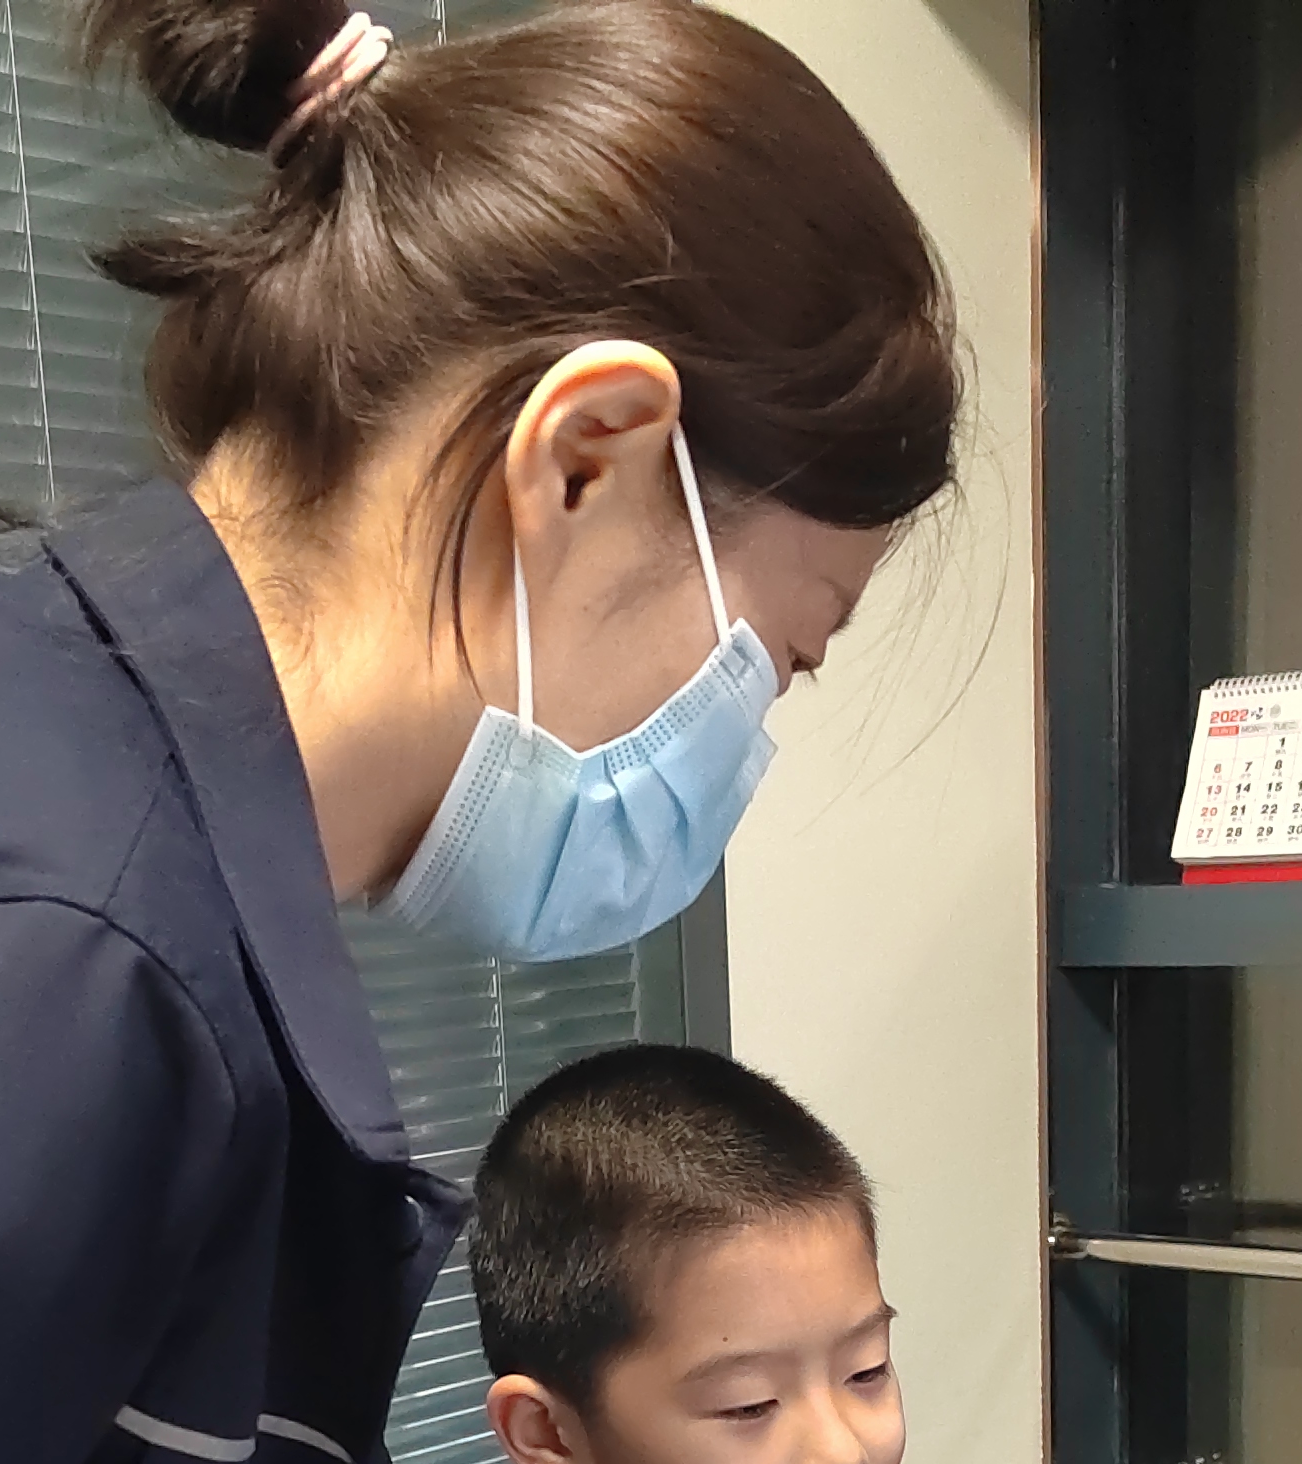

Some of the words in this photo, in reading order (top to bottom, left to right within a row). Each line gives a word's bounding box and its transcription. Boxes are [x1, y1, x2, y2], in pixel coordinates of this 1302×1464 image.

[1210, 709, 1249, 724] 2022
[1279, 737, 1286, 748] 1
[1245, 761, 1253, 772] 7
[1275, 760, 1283, 769] 8
[1206, 785, 1222, 795] 13
[1236, 783, 1251, 793] 14
[1266, 782, 1283, 792] 15
[1201, 807, 1218, 817] 20
[1230, 804, 1246, 816] 21
[1261, 804, 1278, 814] 22
[1196, 828, 1213, 838] 27
[1225, 827, 1242, 837] 28
[1257, 826, 1273, 837] 29
